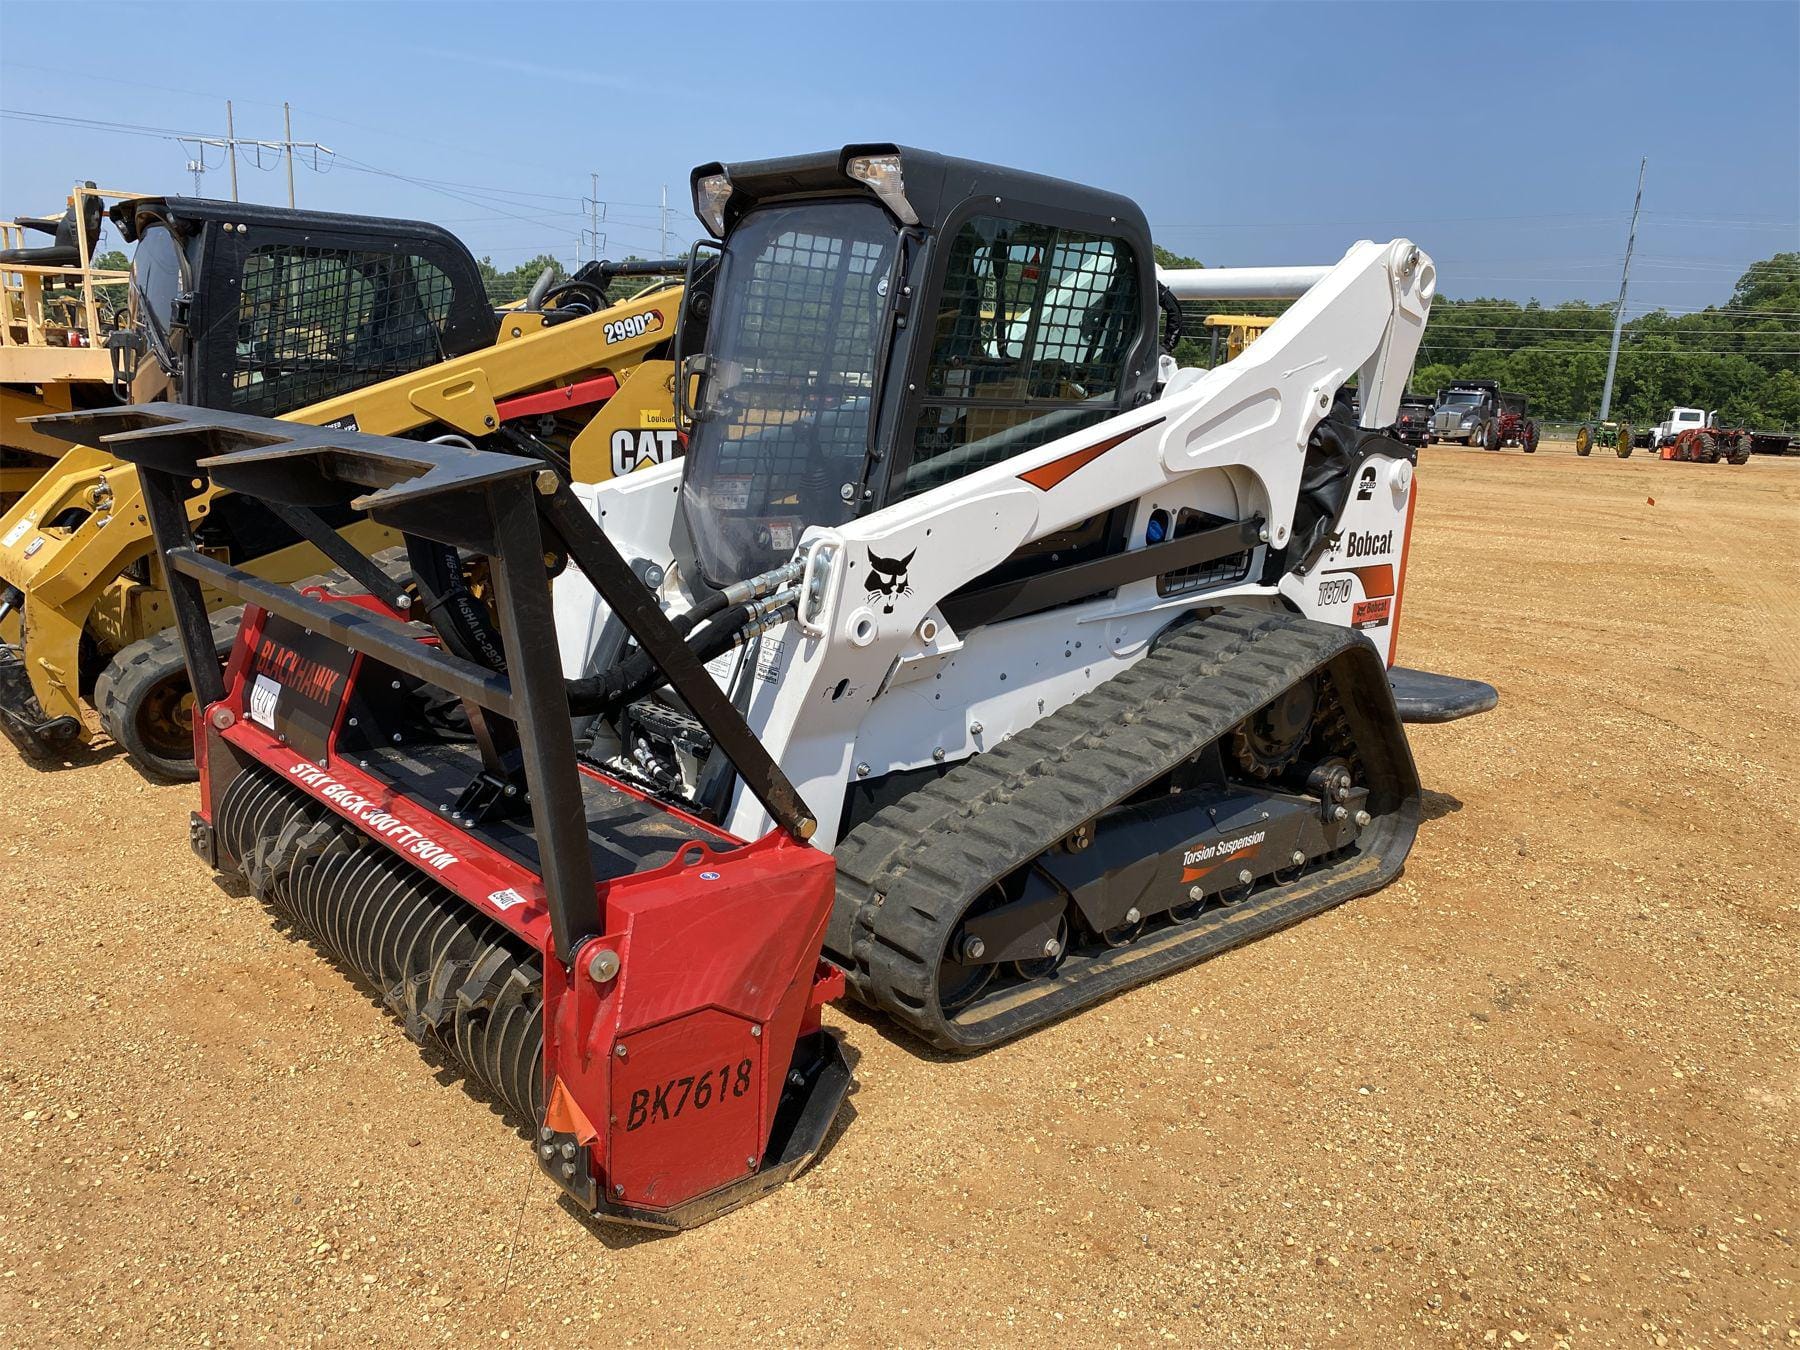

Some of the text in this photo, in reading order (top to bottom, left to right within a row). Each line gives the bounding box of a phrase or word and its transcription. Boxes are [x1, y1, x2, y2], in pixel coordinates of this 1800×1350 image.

[611, 429, 678, 478] CAT
[1347, 529, 1393, 557] Bobcat
[1318, 578, 1352, 606] T870
[1366, 600, 1387, 614] Bobcat
[257, 640, 340, 706] BLACKHAWK
[289, 763, 337, 788] STAY
[321, 783, 376, 815] BACK
[360, 808, 401, 831] 300
[1183, 831, 1265, 866] Torsion Suspension
[626, 1058, 753, 1132] BK7618
